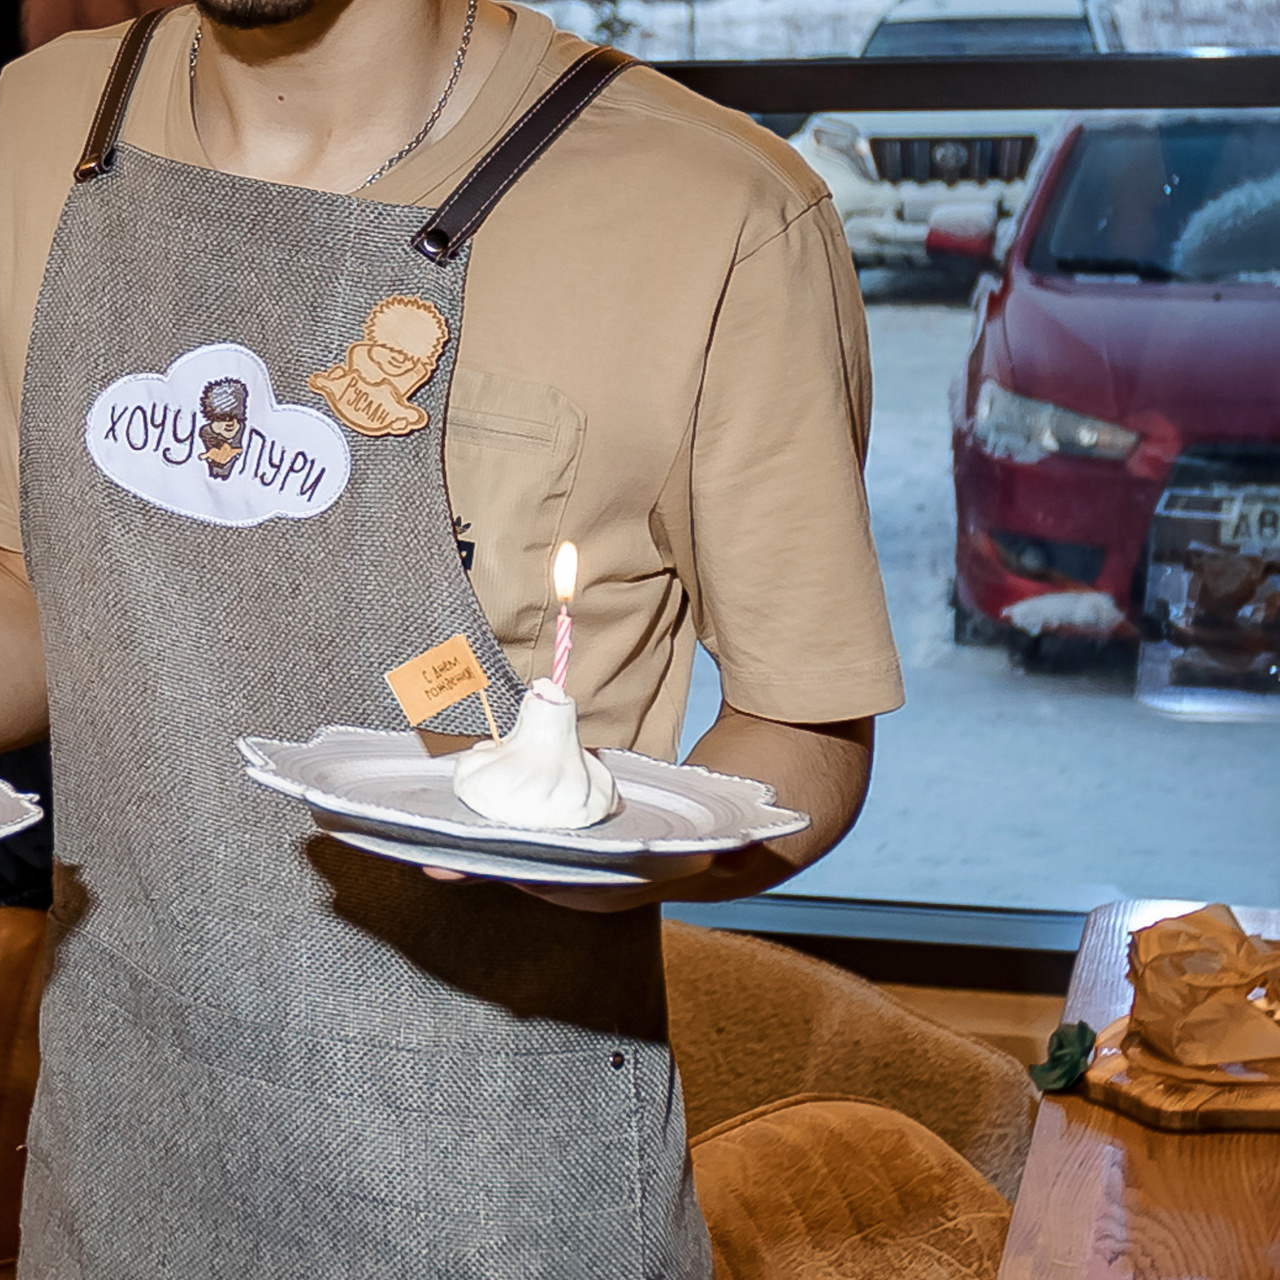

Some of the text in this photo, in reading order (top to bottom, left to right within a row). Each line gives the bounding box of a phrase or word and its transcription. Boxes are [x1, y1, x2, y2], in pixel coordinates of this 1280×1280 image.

[338, 376, 390, 425] РУСЛАН
[104, 402, 327, 503] ХОЧУ ПУРИ
[422, 670, 433, 684] С
